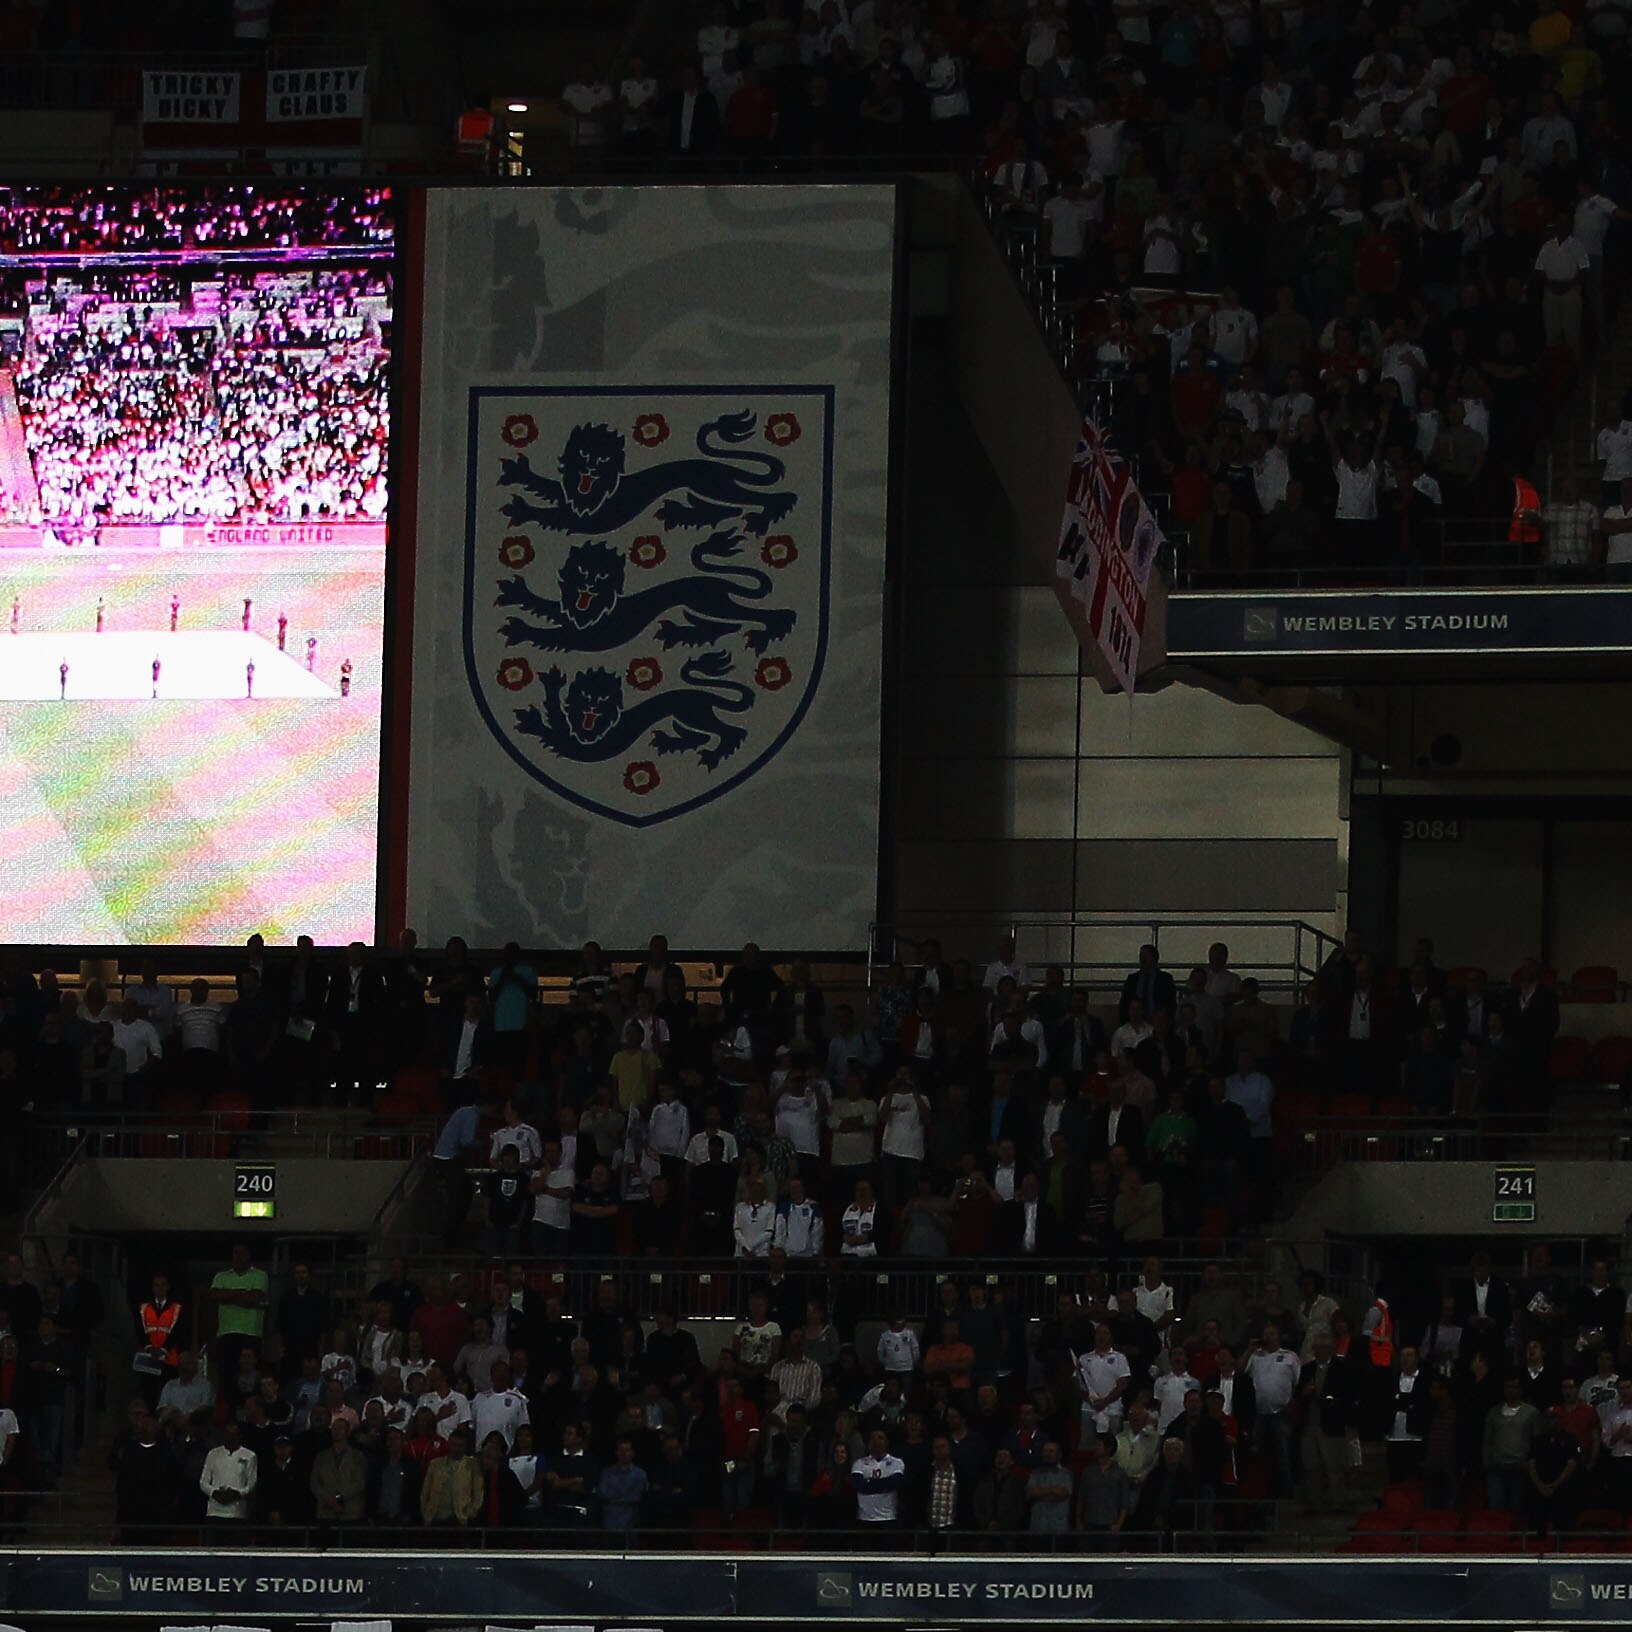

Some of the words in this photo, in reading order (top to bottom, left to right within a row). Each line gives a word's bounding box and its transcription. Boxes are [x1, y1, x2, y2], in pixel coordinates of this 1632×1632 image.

[150, 73, 235, 97] TRICKY
[271, 69, 360, 95] CRAFTY
[157, 98, 227, 120] DICKY
[278, 92, 348, 116] CLAUS
[1282, 615, 1396, 634] WEMBLEY
[1404, 613, 1509, 632] STADIUM
[1400, 818, 1458, 840] 3084
[236, 1174, 273, 1193] 240
[1498, 1176, 1534, 1195] 241
[129, 1575, 246, 1594] WEMBLEY
[254, 1575, 364, 1595] STADIUM
[858, 1580, 978, 1600] WEMBLEY
[985, 1581, 1095, 1601] STADIUM
